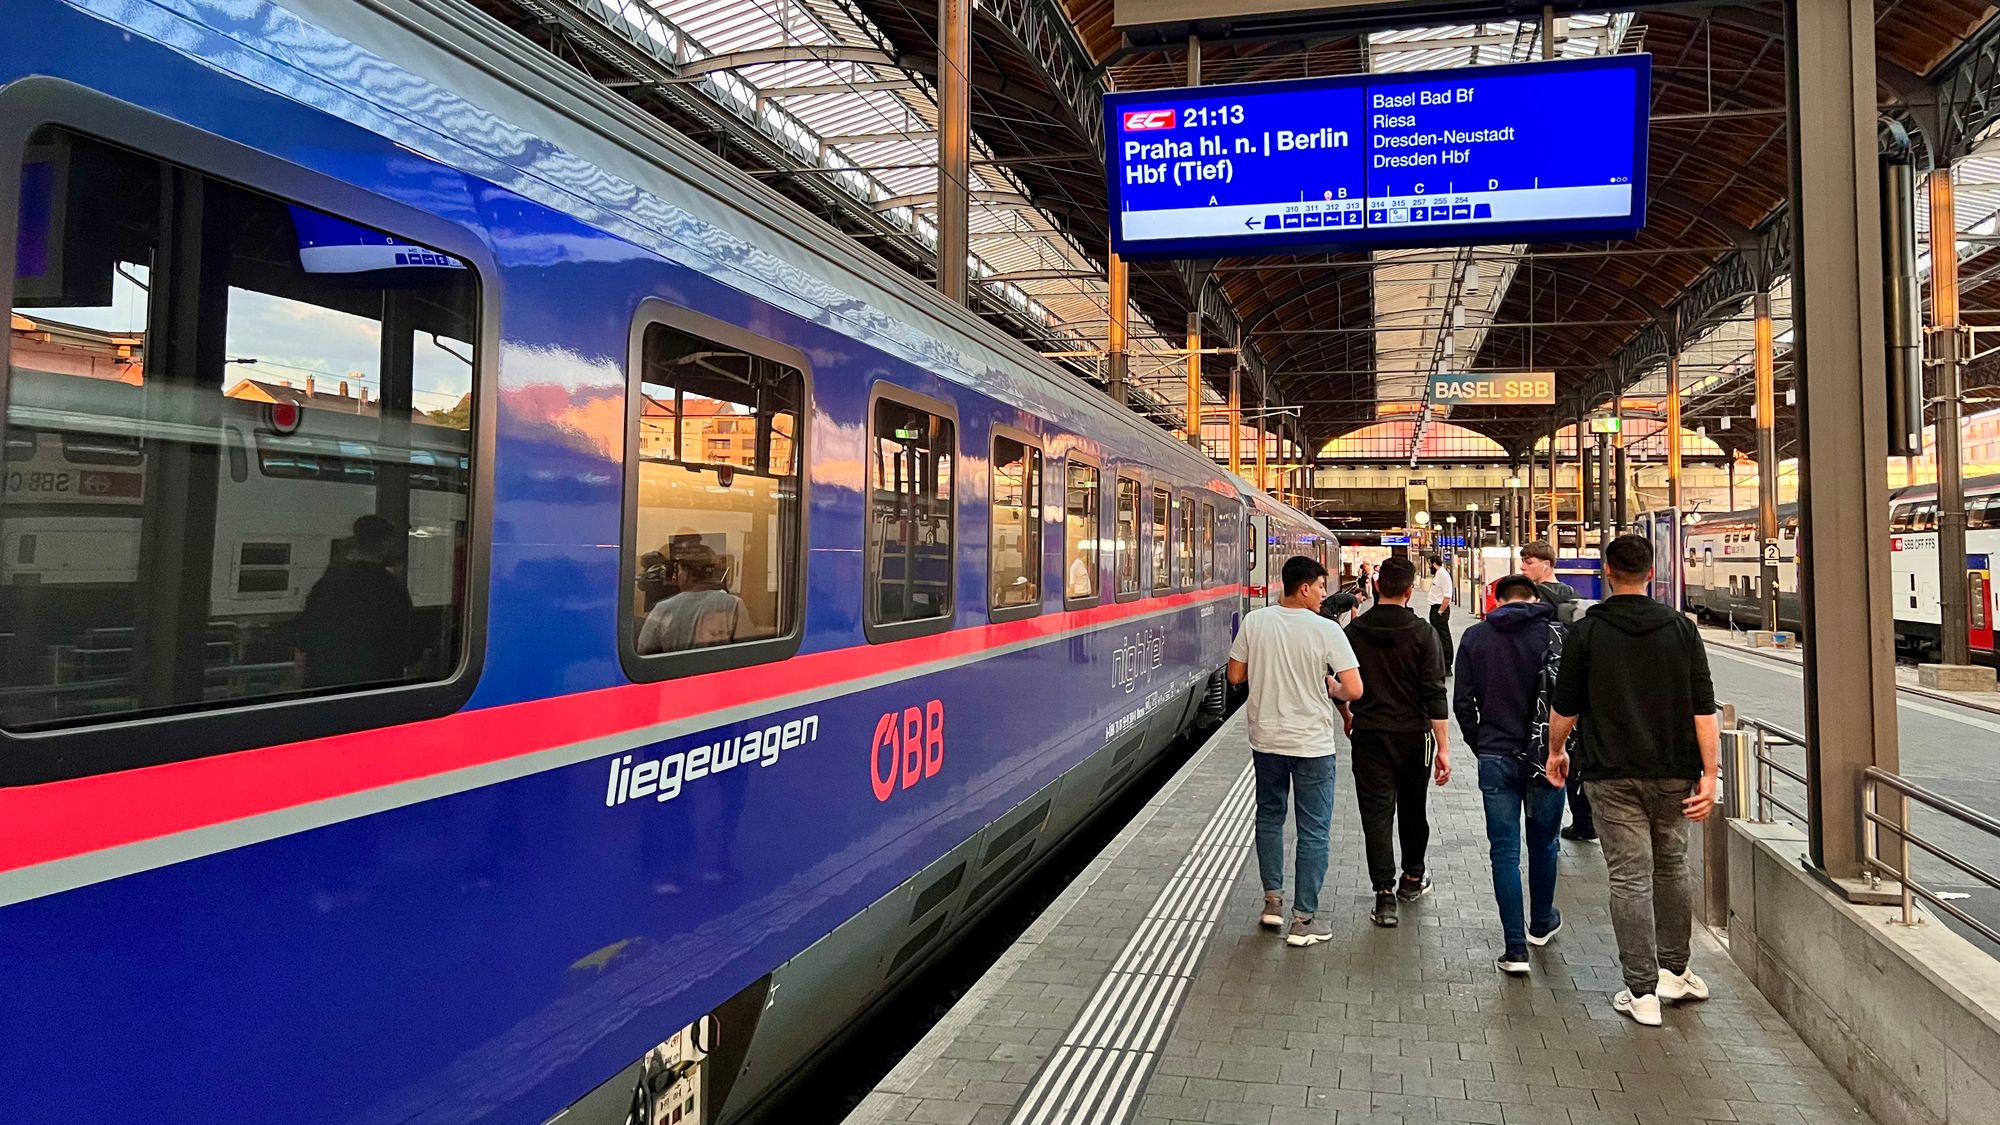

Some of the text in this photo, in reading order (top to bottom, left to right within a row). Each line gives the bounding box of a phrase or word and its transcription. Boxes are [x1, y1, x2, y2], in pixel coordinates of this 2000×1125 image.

[1373, 87, 1475, 109] Basel Bad Bf
[1125, 104, 1245, 129] EC 21:13
[1373, 113, 1416, 129] Riesa
[1125, 138, 1194, 161] Praha
[1200, 135, 1228, 156] hl.
[1235, 137, 1257, 154] n.
[1277, 127, 1349, 151] Berlin
[1374, 126, 1515, 149] Dresden-Neustadt
[1374, 149, 1471, 169] Dresden Hbf
[1126, 158, 1234, 186] Hbf (Tief)
[1414, 183, 1425, 194] C
[1488, 179, 1499, 190] D
[1208, 195, 1219, 206] A
[1338, 187, 1348, 199] B
[1326, 203, 1340, 211] 312
[1346, 202, 1360, 210] 313
[1416, 210, 1424, 219] 2
[1349, 213, 1357, 223] 2
[1374, 212, 1382, 222] 2
[1435, 381, 1550, 399] BASEL SBB
[1768, 547, 1776, 559] 2
[870, 699, 945, 802] ÖBB
[605, 714, 820, 808] liegewagen
